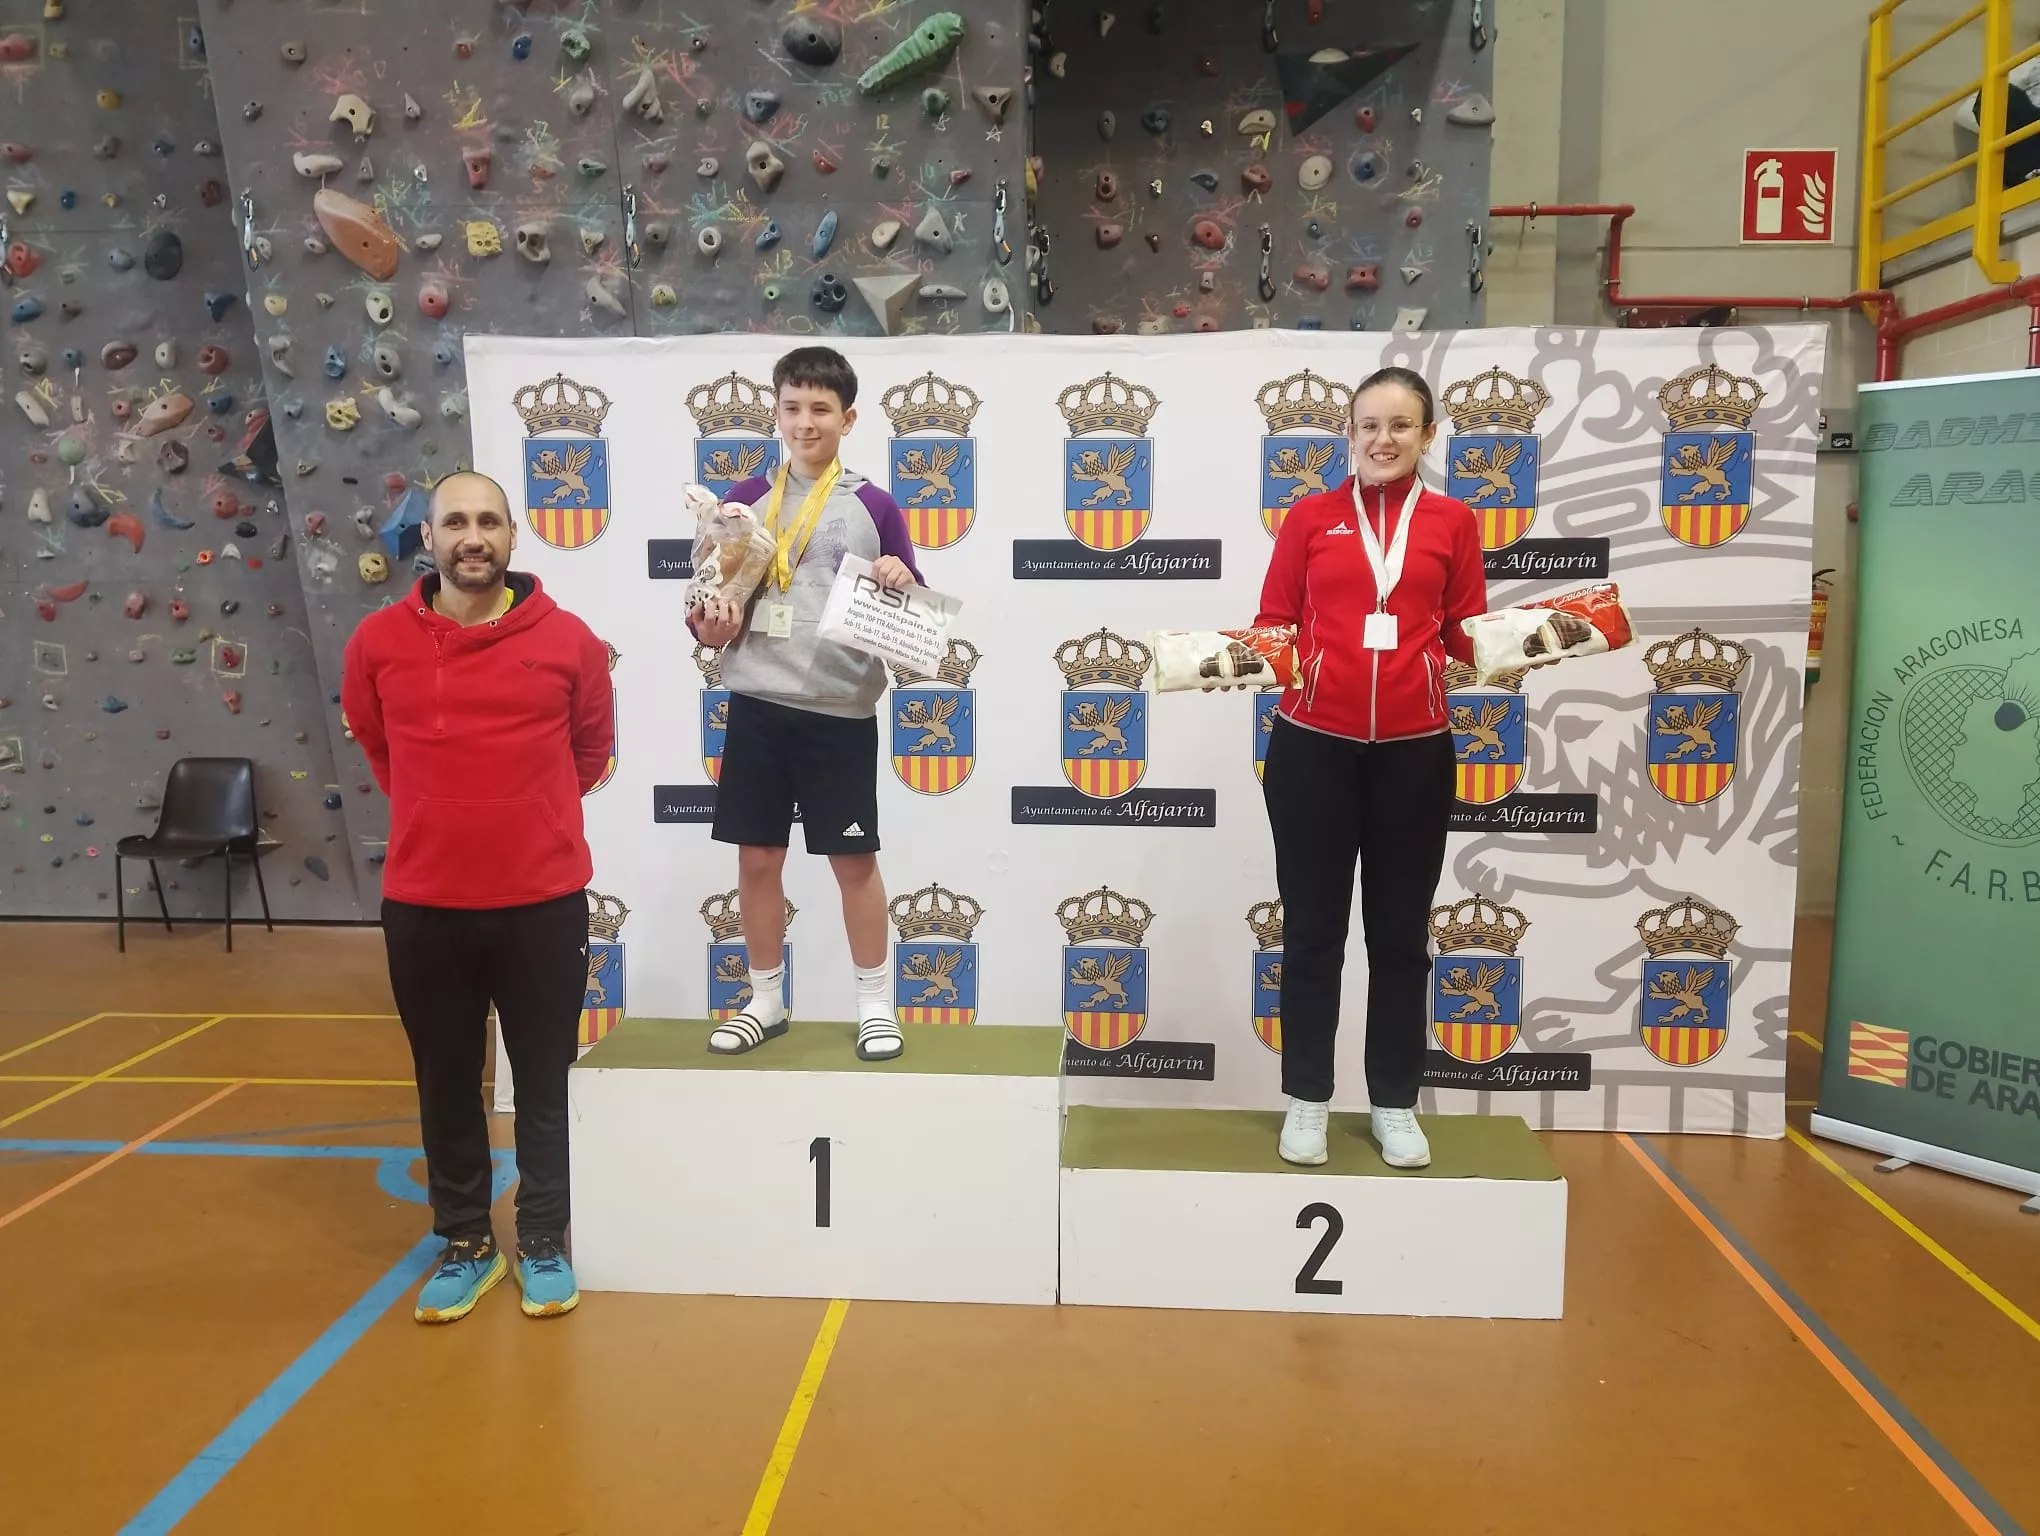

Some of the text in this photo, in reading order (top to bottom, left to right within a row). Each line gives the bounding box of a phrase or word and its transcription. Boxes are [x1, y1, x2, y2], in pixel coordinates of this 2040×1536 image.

[1021, 551, 1212, 575] Ayuntamiento de Alfajarín
[1484, 551, 1598, 575] de Alfajarín
[853, 573, 921, 618] RSL
[853, 598, 939, 636] www.rslspain.es
[1893, 617, 2024, 686] ARAGONESA
[1858, 690, 1894, 821] FEDERACION
[1020, 799, 1207, 822] Ayuntamiento de Alfajarín
[1474, 811, 1488, 823] de
[1491, 805, 1586, 828] Alfajarín
[1100, 1057, 1112, 1067] de
[1116, 1052, 1205, 1074] Alfajarín
[1471, 1070, 1484, 1081] de
[1487, 1064, 1580, 1087] Alfajarín
[1910, 1064, 1958, 1101] DE
[808, 1136, 831, 1229] 1
[1294, 1202, 1345, 1296] 2
